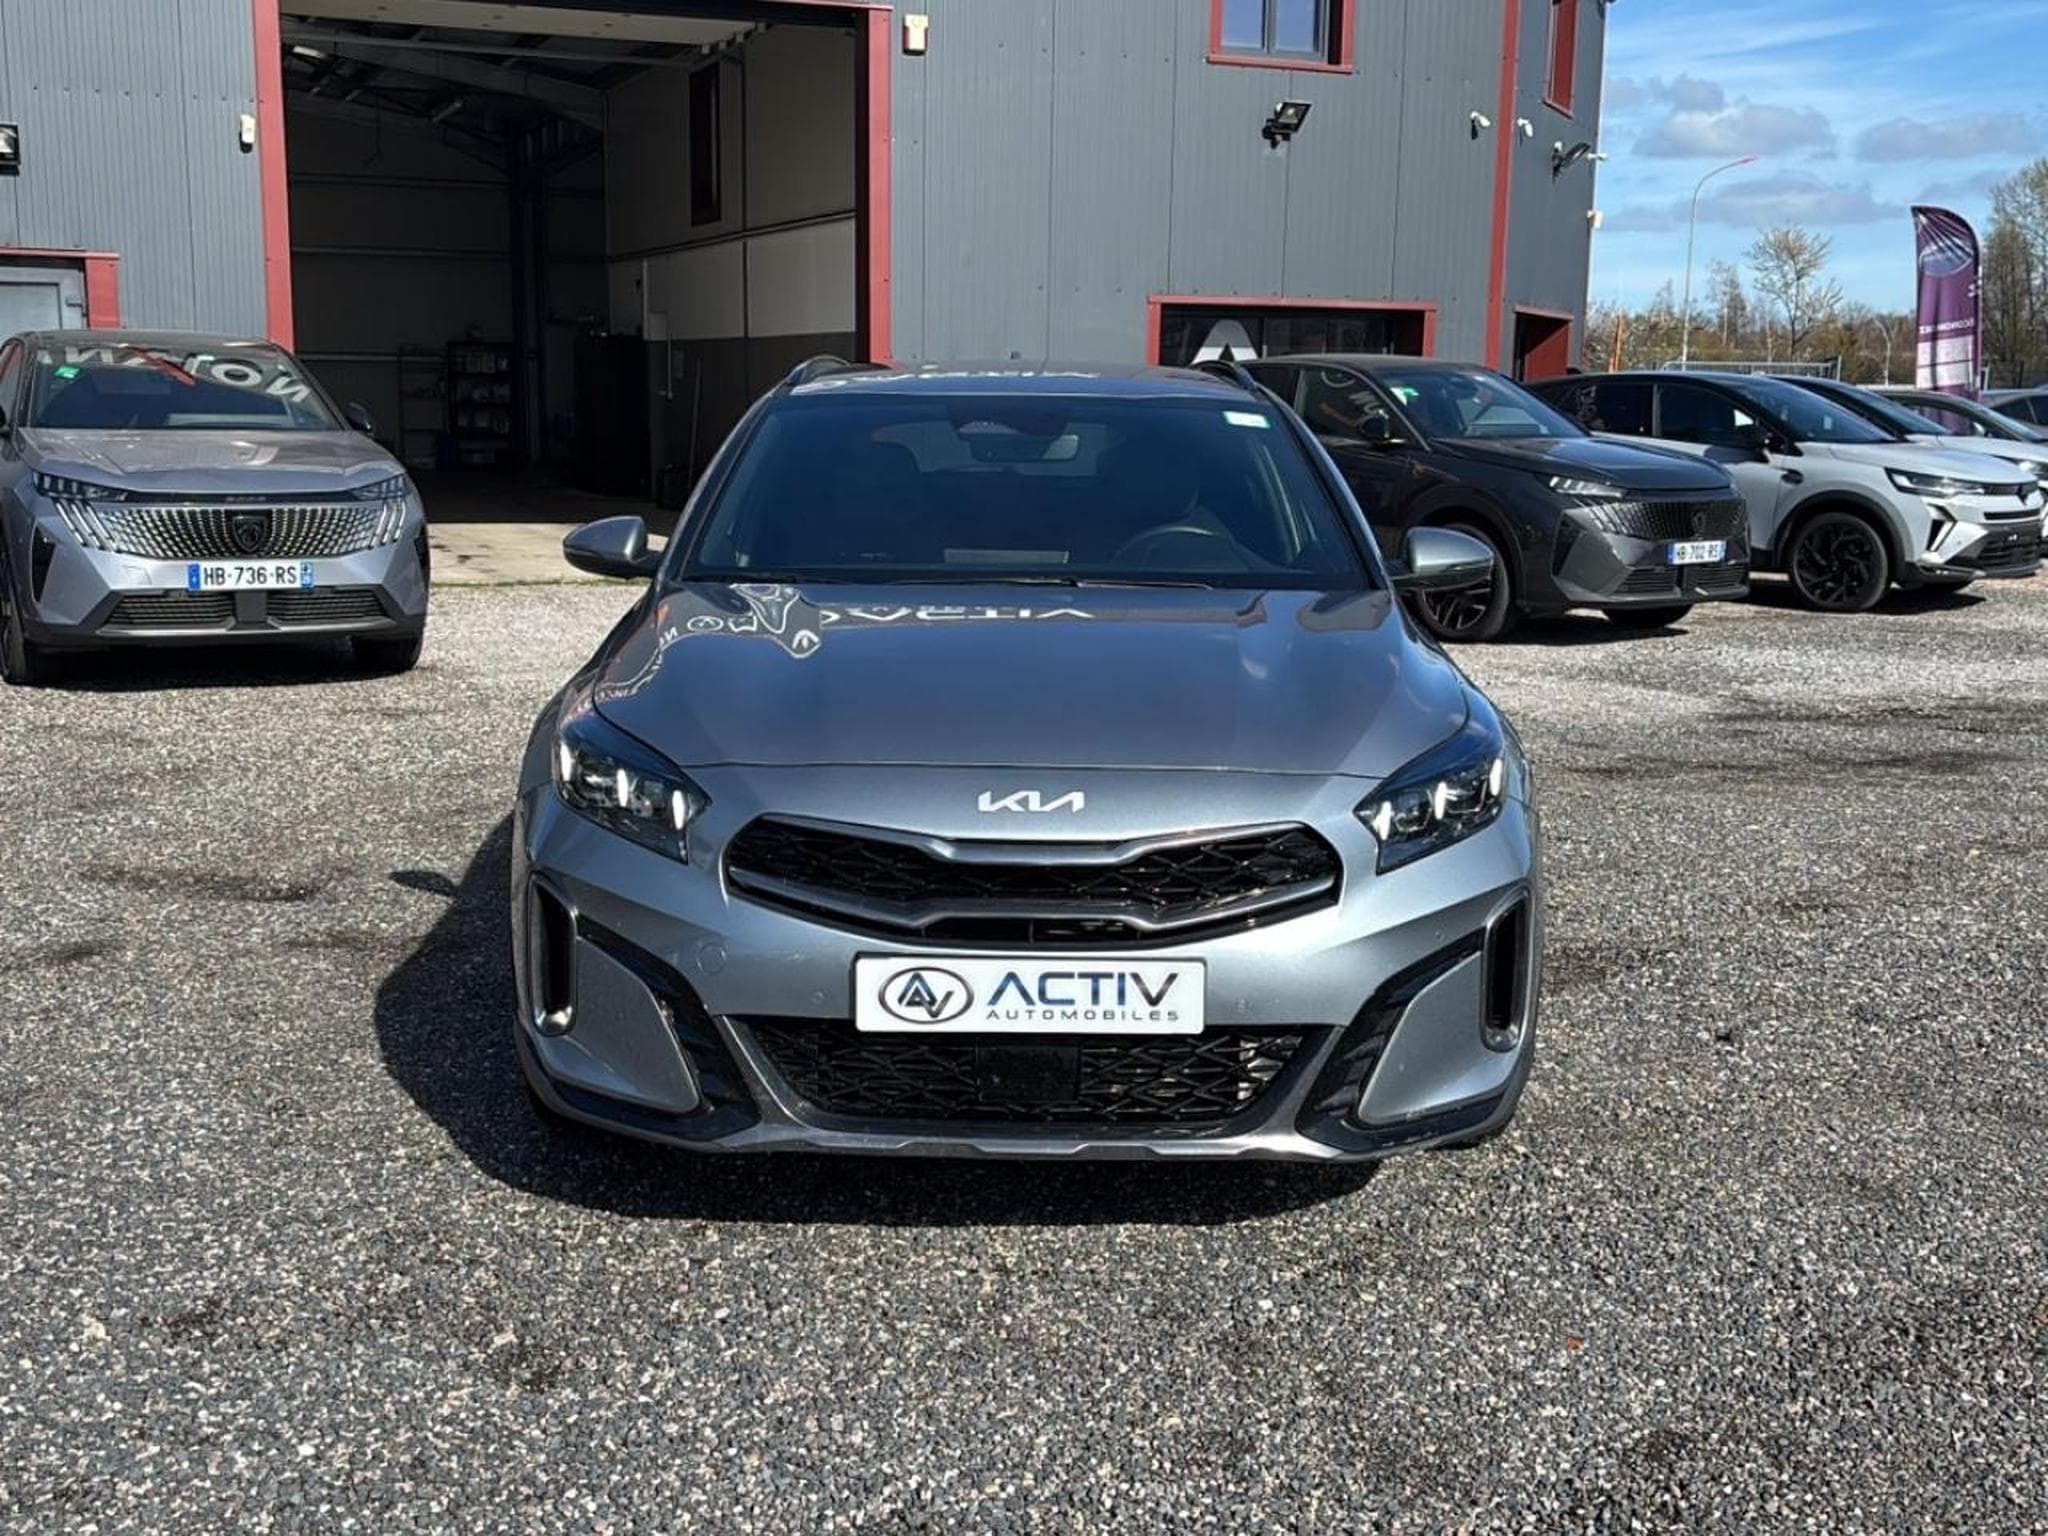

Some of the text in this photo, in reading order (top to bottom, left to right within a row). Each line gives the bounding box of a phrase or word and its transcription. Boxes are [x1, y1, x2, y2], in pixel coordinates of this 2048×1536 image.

[203, 566, 297, 585] HB-736-RS
[987, 971, 1179, 1007] ACTIV
[986, 1010, 1179, 1021] AUTOMOBILES
